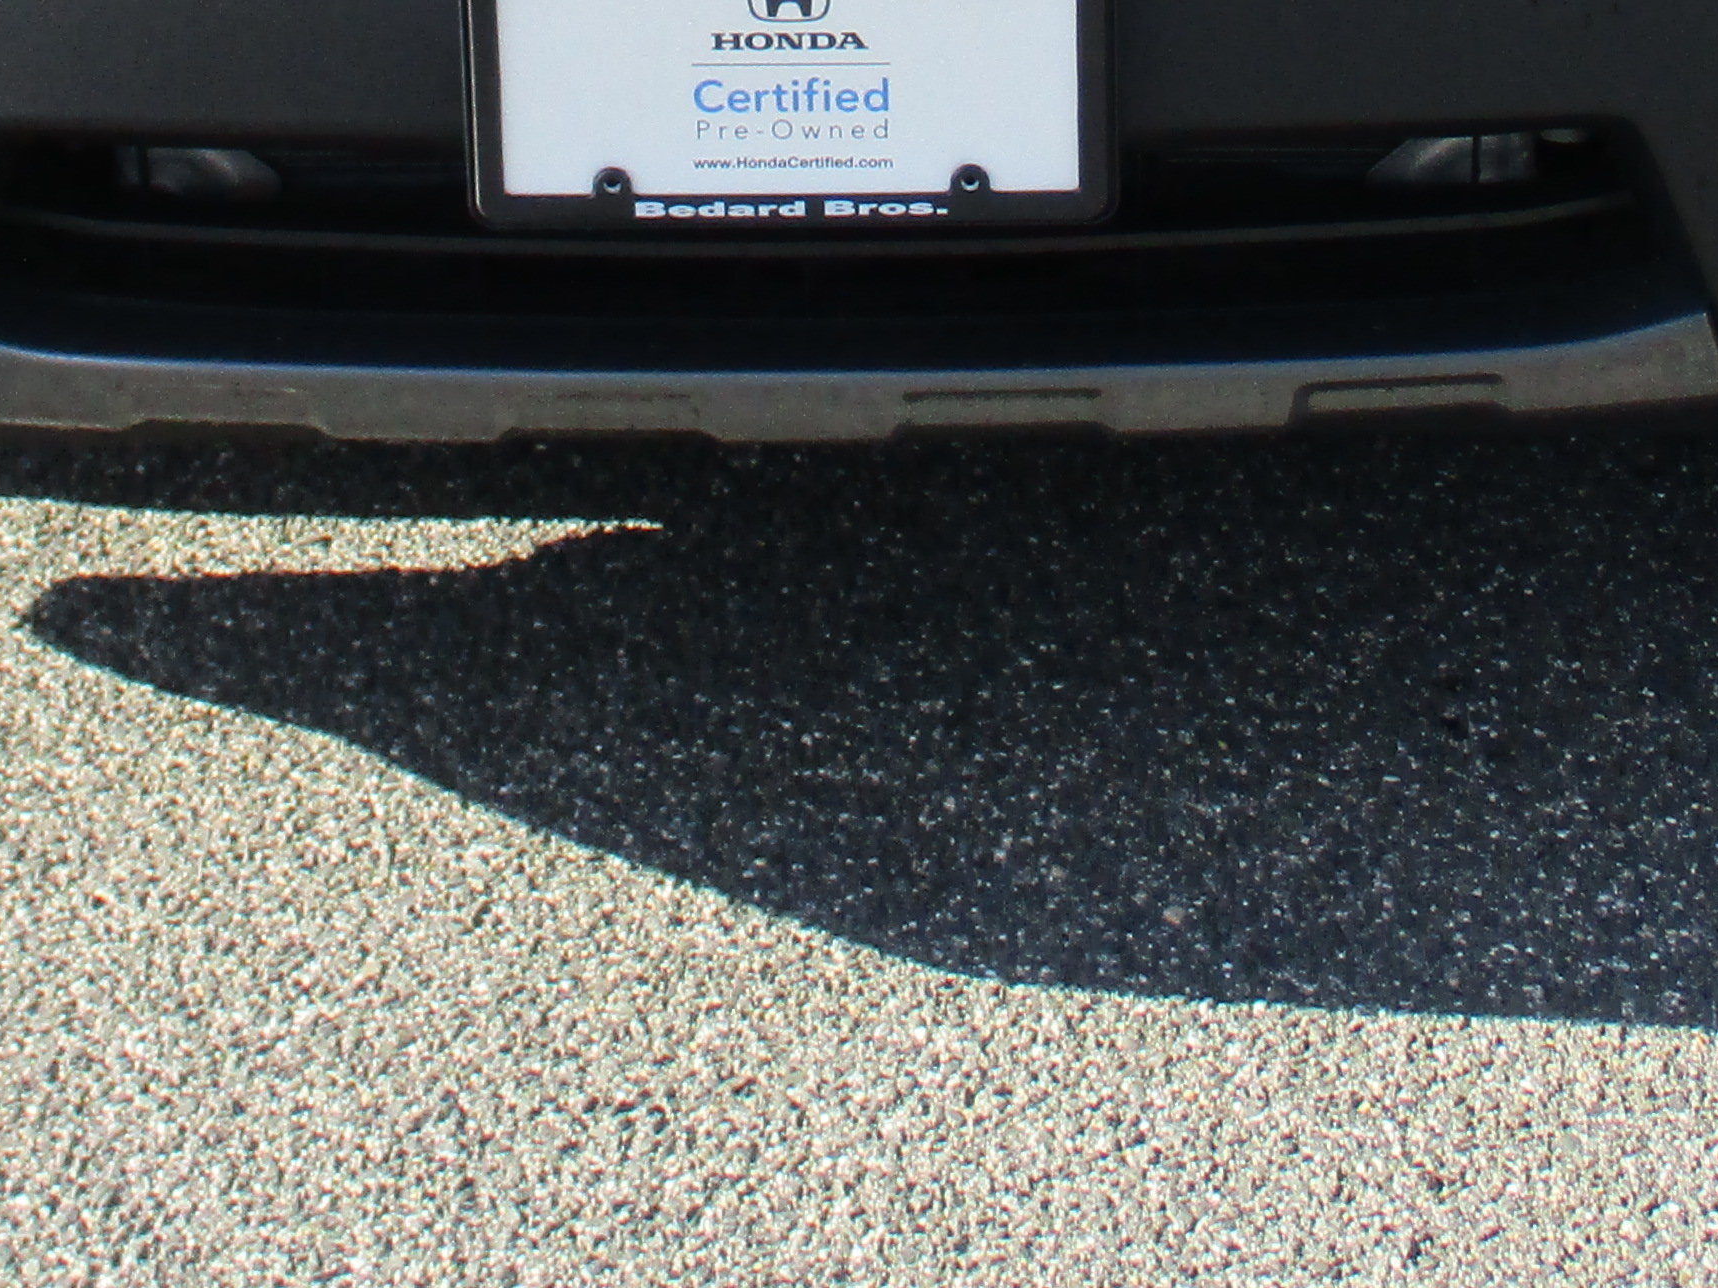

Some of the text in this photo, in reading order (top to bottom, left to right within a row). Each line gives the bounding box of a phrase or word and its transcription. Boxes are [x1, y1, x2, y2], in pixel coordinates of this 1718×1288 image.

[710, 31, 869, 51] HONDA
[693, 76, 890, 113] Certified
[696, 118, 889, 140] Pre-Owned
[693, 155, 894, 170] www.HondaCertified.com
[634, 199, 949, 218] Bedard Bros.
